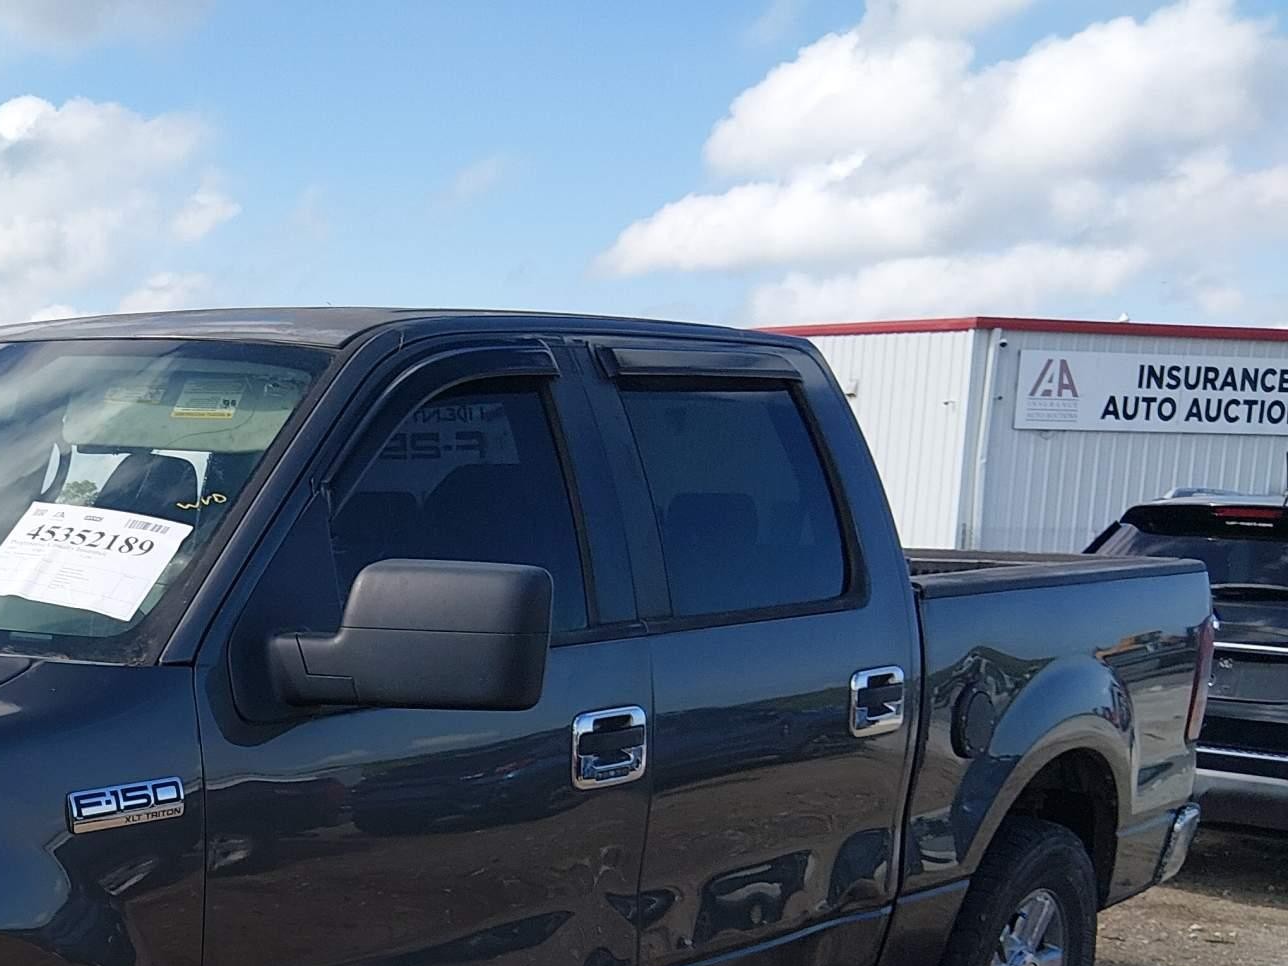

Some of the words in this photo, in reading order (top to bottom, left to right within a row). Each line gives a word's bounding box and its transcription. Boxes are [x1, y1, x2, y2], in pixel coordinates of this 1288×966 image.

[1137, 364, 1288, 393] INSURANCE
[1100, 395, 1177, 422] AUTO
[1184, 397, 1288, 425] AUCTIO
[26, 523, 155, 557] 45352189
[70, 778, 183, 820] F-150
[124, 814, 142, 824] XLT
[145, 807, 182, 820] TRITON
